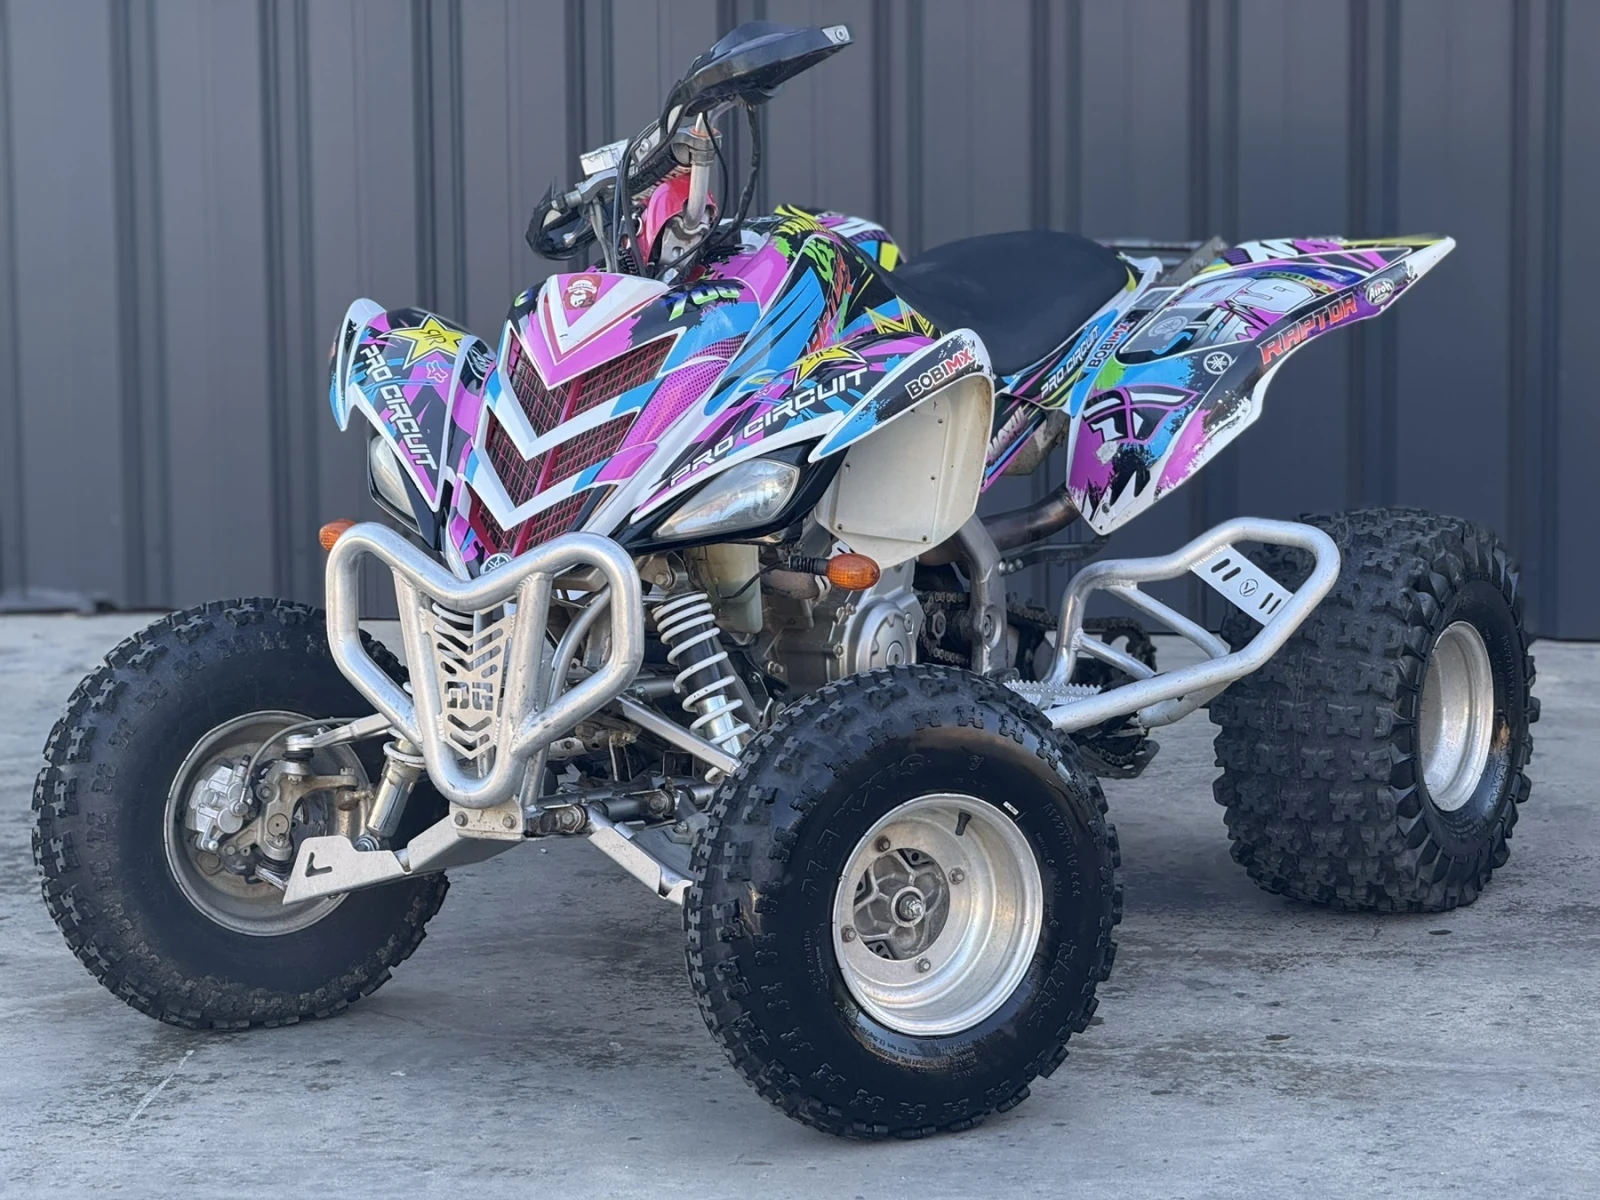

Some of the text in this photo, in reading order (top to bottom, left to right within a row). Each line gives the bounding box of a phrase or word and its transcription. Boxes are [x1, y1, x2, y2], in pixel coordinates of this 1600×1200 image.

[1040, 325, 1100, 399] PRO CIRCUIT
[1086, 319, 1136, 369] BOBIMX
[1257, 290, 1358, 365] RAPTOR
[360, 344, 438, 470] PRO CIRCUIT
[905, 347, 976, 399] BOBIMX
[670, 366, 868, 487] PRO CIRCUIT
